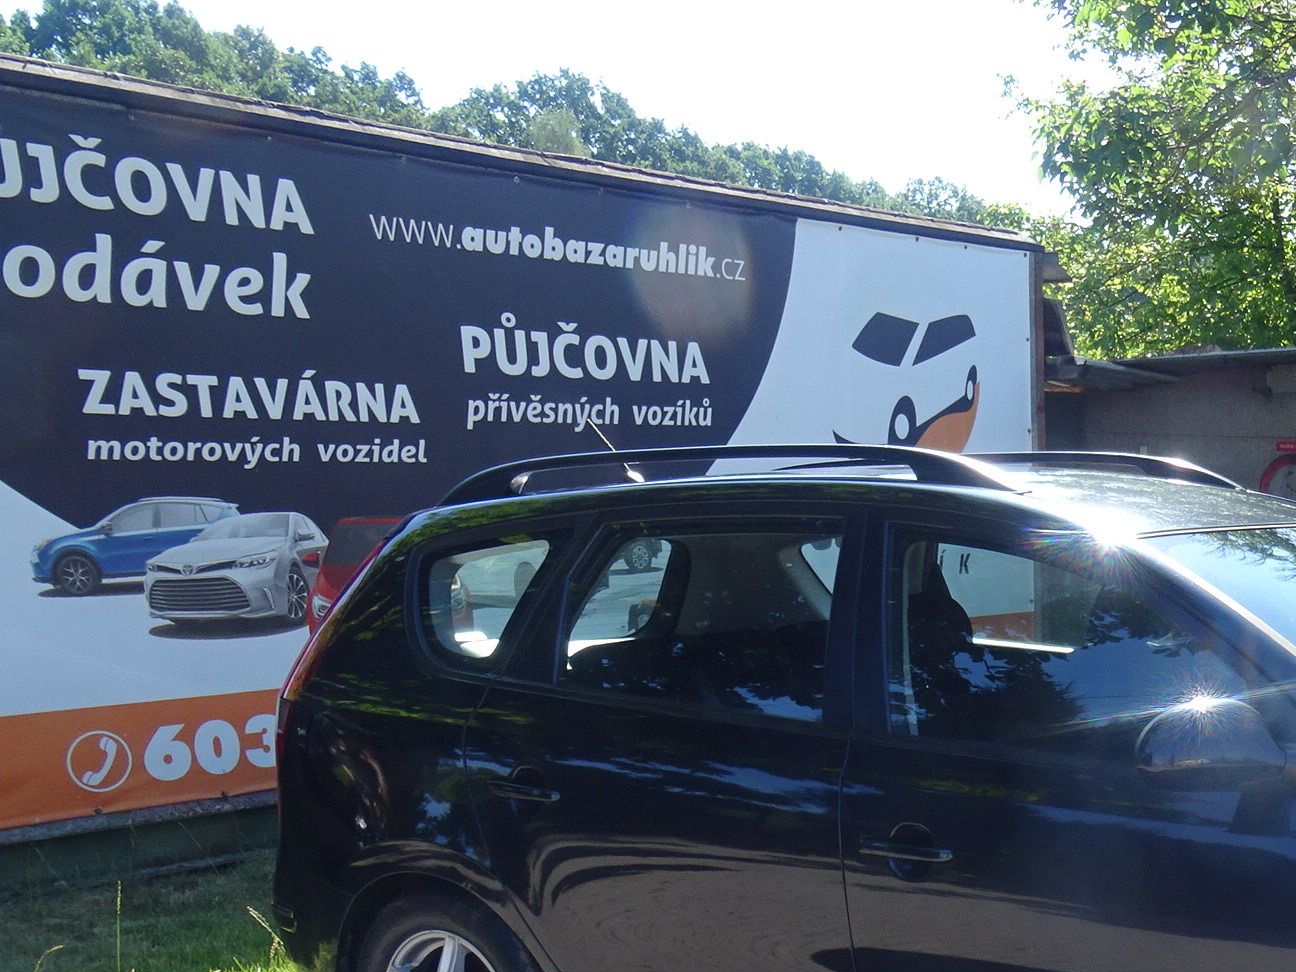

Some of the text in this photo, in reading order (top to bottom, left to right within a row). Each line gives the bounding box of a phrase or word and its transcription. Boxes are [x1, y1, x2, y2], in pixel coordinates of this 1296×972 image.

[2, 233, 312, 320] odávek
[369, 214, 746, 281] www.autobazaruhlik.cz
[460, 312, 711, 385] PŮJČOVNA
[77, 368, 421, 425] ZASTAVÁRNA
[467, 393, 713, 433] přívěsných vozíků
[86, 436, 428, 470] motorových vozidel
[143, 713, 278, 782] 603
